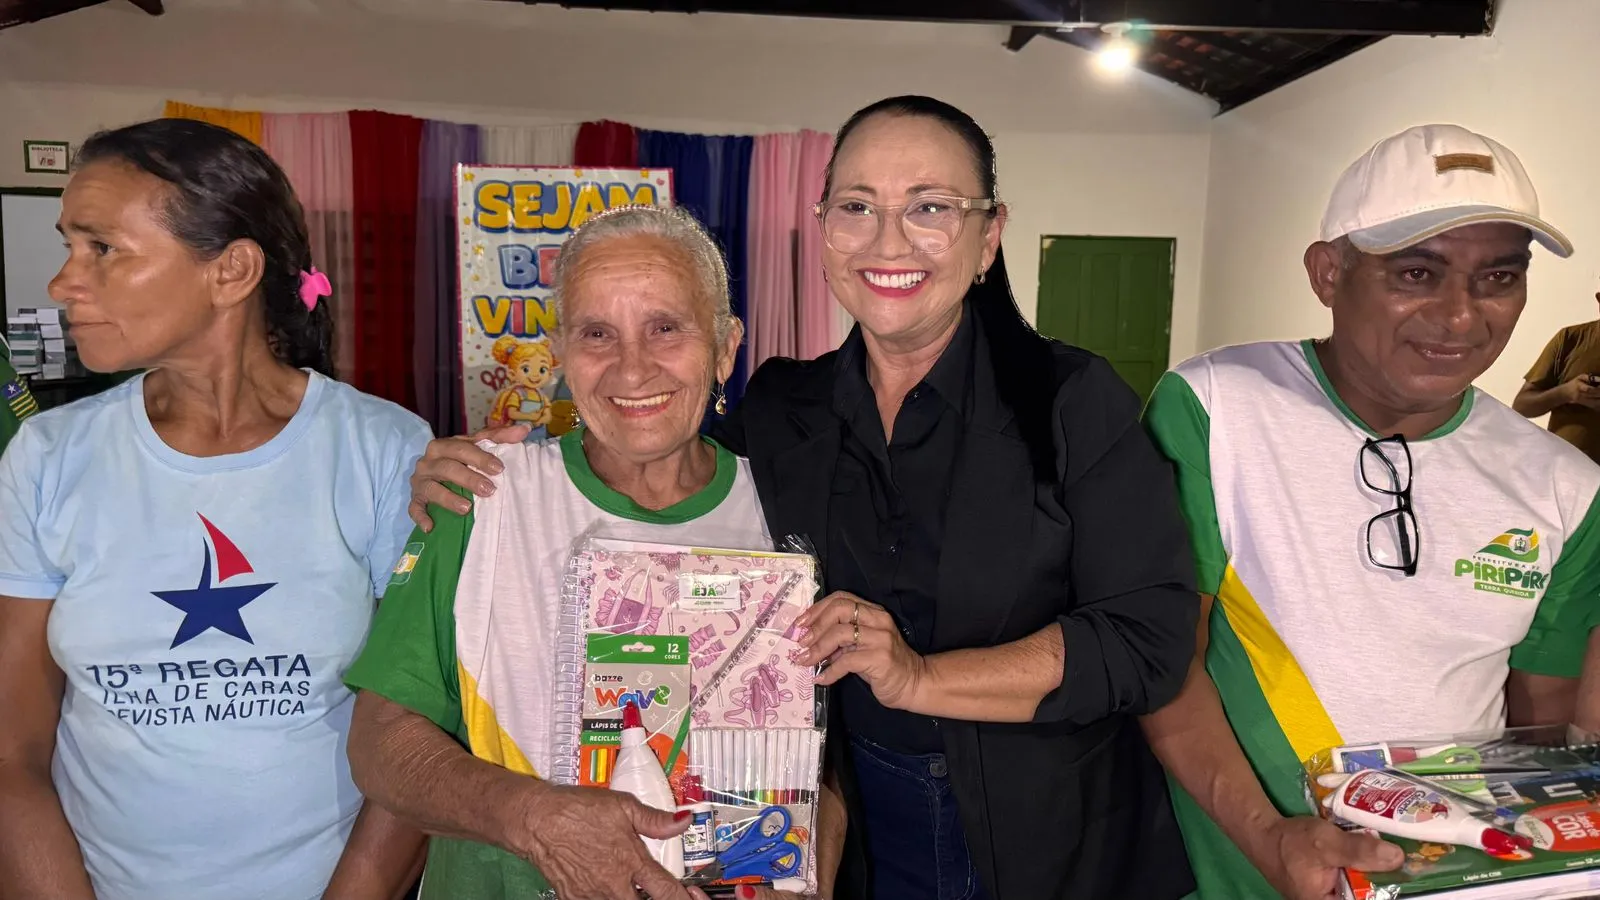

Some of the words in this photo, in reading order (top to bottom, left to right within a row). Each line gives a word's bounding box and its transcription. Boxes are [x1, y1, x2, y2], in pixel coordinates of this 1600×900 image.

[498, 244, 562, 289] BE
[694, 586, 717, 596] EJA
[667, 643, 679, 653] 12
[86, 664, 143, 688] 15ª
[158, 654, 311, 683] REGATA
[594, 673, 624, 682] bazze
[103, 687, 160, 705] ILHA
[175, 682, 208, 702] DE
[224, 680, 310, 698] CARAS
[205, 698, 305, 722] NÁUTICA
[1552, 815, 1587, 840] COR
